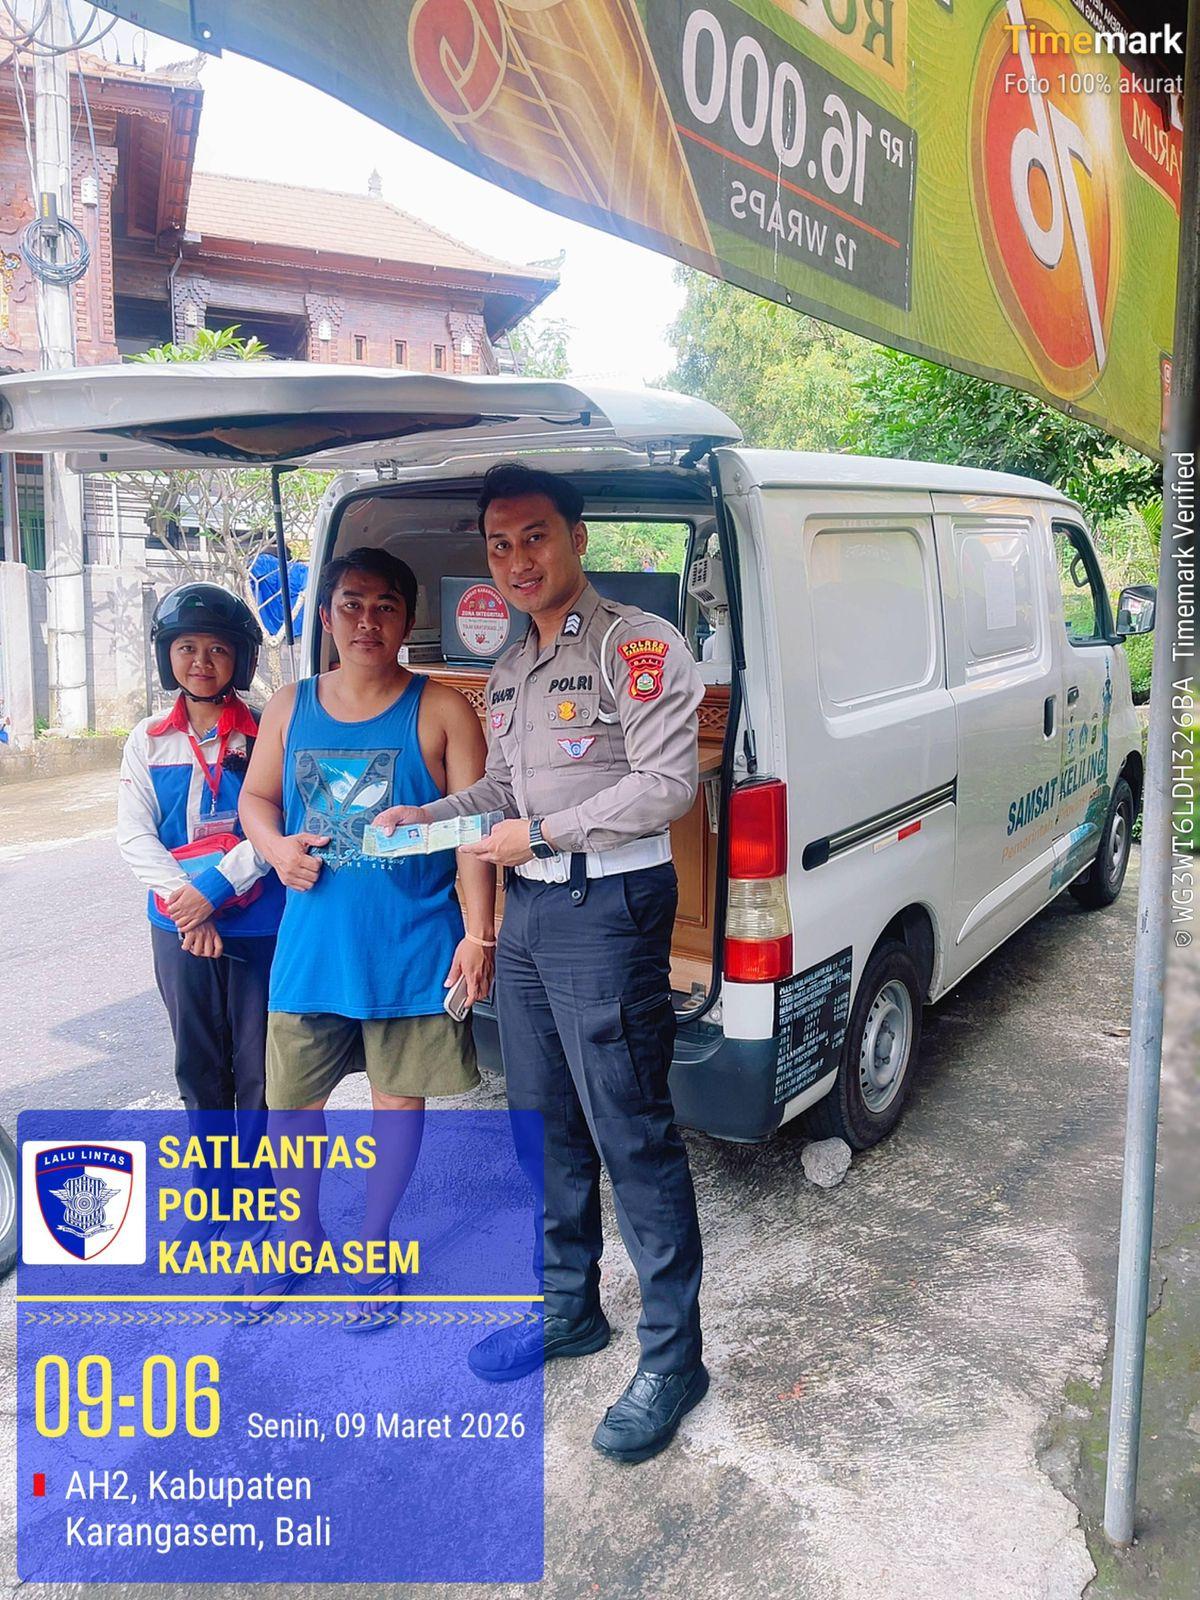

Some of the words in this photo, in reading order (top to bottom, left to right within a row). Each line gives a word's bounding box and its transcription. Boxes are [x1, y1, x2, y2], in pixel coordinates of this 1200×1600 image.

[633, 658, 659, 666] BALI
[548, 675, 593, 693] POLRI
[1007, 776, 1058, 837] SAMSAT
[1059, 747, 1106, 801] KELILING
